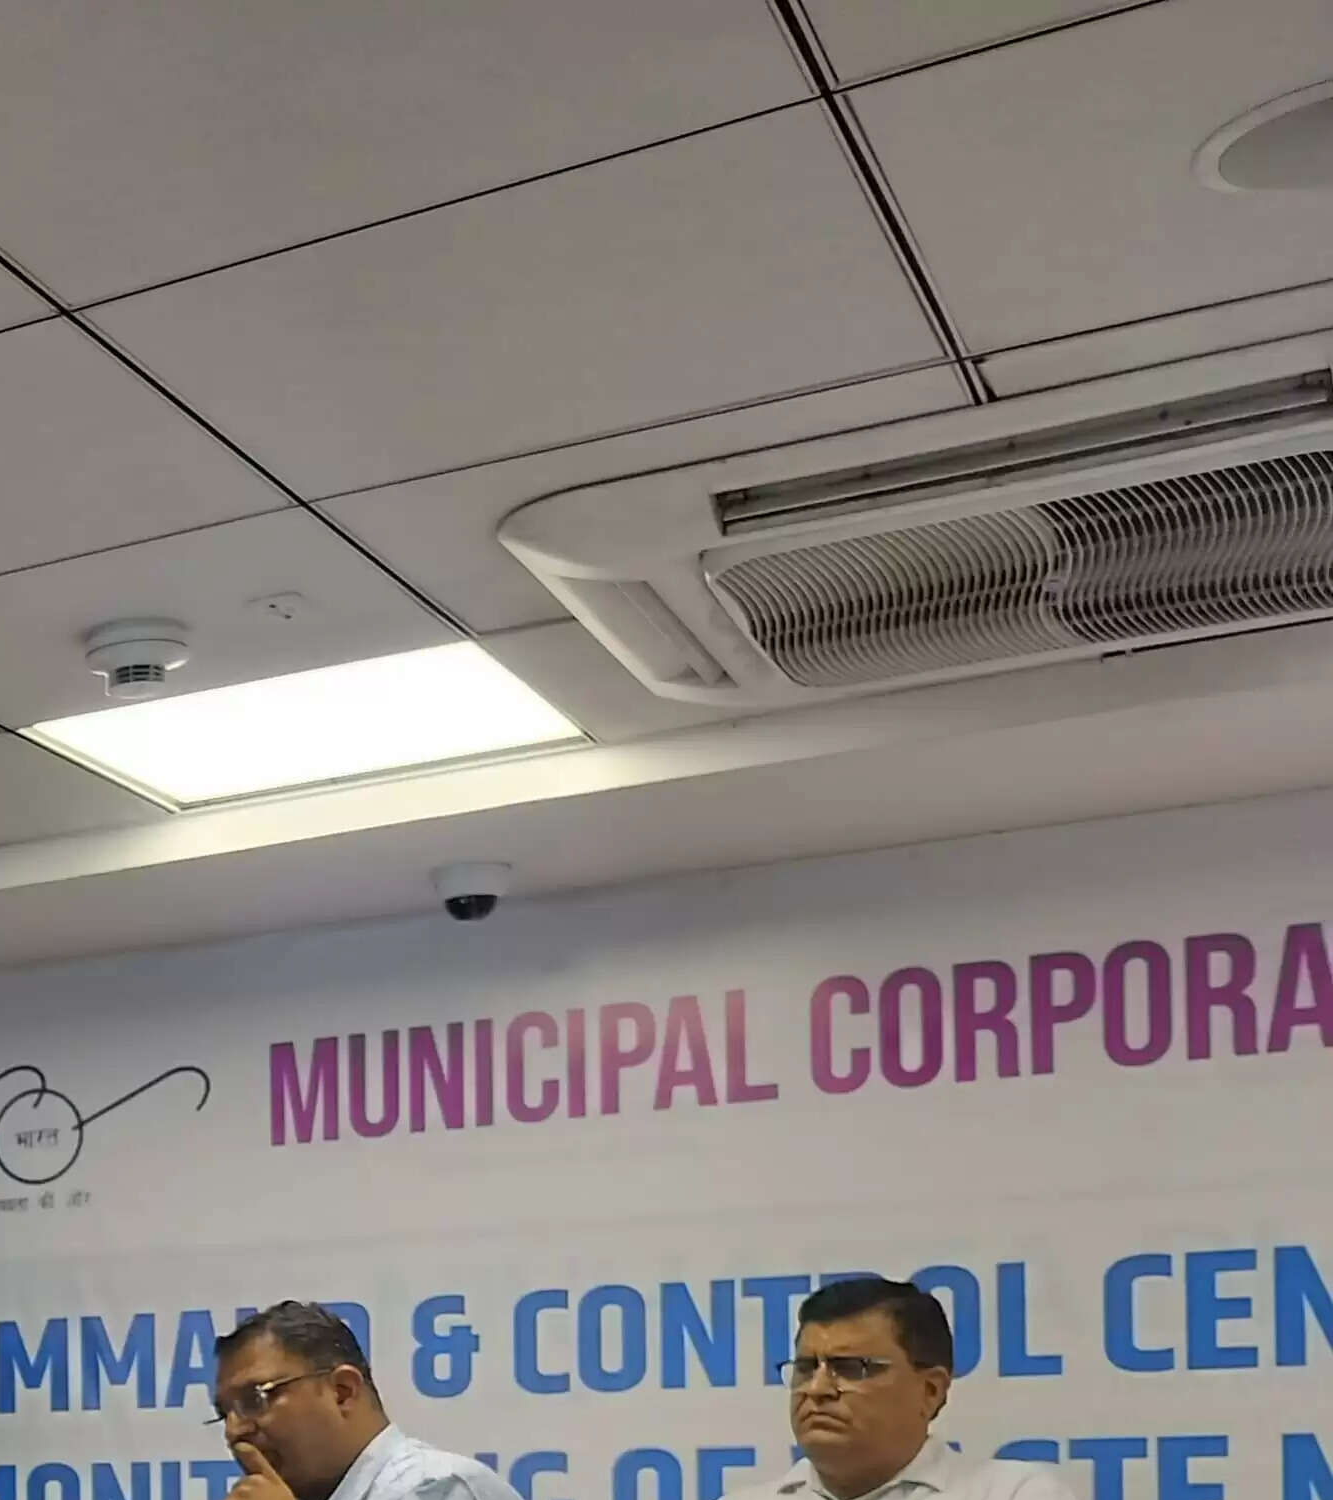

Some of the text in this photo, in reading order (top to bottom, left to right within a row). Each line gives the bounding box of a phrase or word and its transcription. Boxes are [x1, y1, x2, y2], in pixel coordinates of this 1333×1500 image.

[269, 988, 779, 1147] MUNICIPAL
[412, 1294, 480, 1398] &
[513, 1261, 1064, 1393] CONTOL
